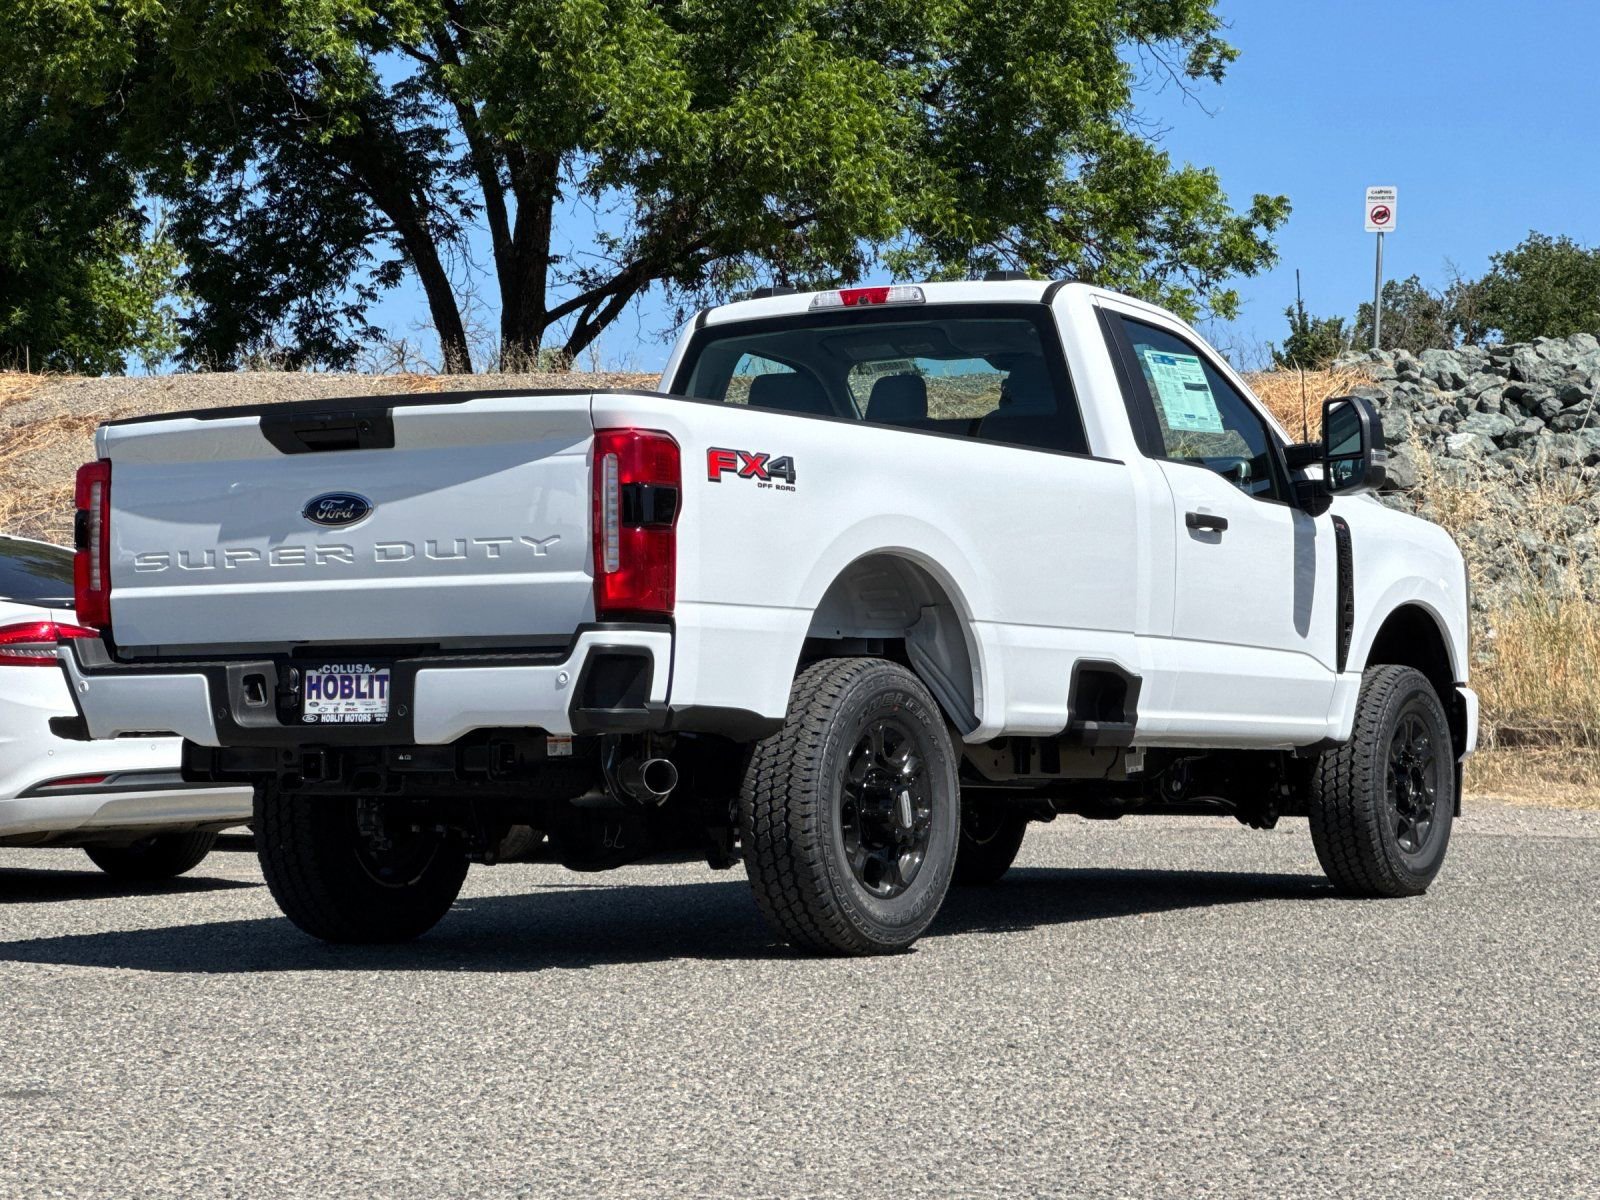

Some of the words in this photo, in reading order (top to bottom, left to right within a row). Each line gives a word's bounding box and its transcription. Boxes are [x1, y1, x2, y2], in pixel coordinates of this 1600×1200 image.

[706, 446, 796, 484] FX4
[775, 484, 796, 492] ROAD
[316, 499, 355, 519] Ford
[134, 543, 355, 573] SUPER
[374, 534, 561, 563] DUTY
[322, 664, 371, 673] COLUSA
[306, 674, 389, 700] HOBLIT
[321, 713, 344, 722] HOBLIT
[344, 713, 371, 722] MOTORS
